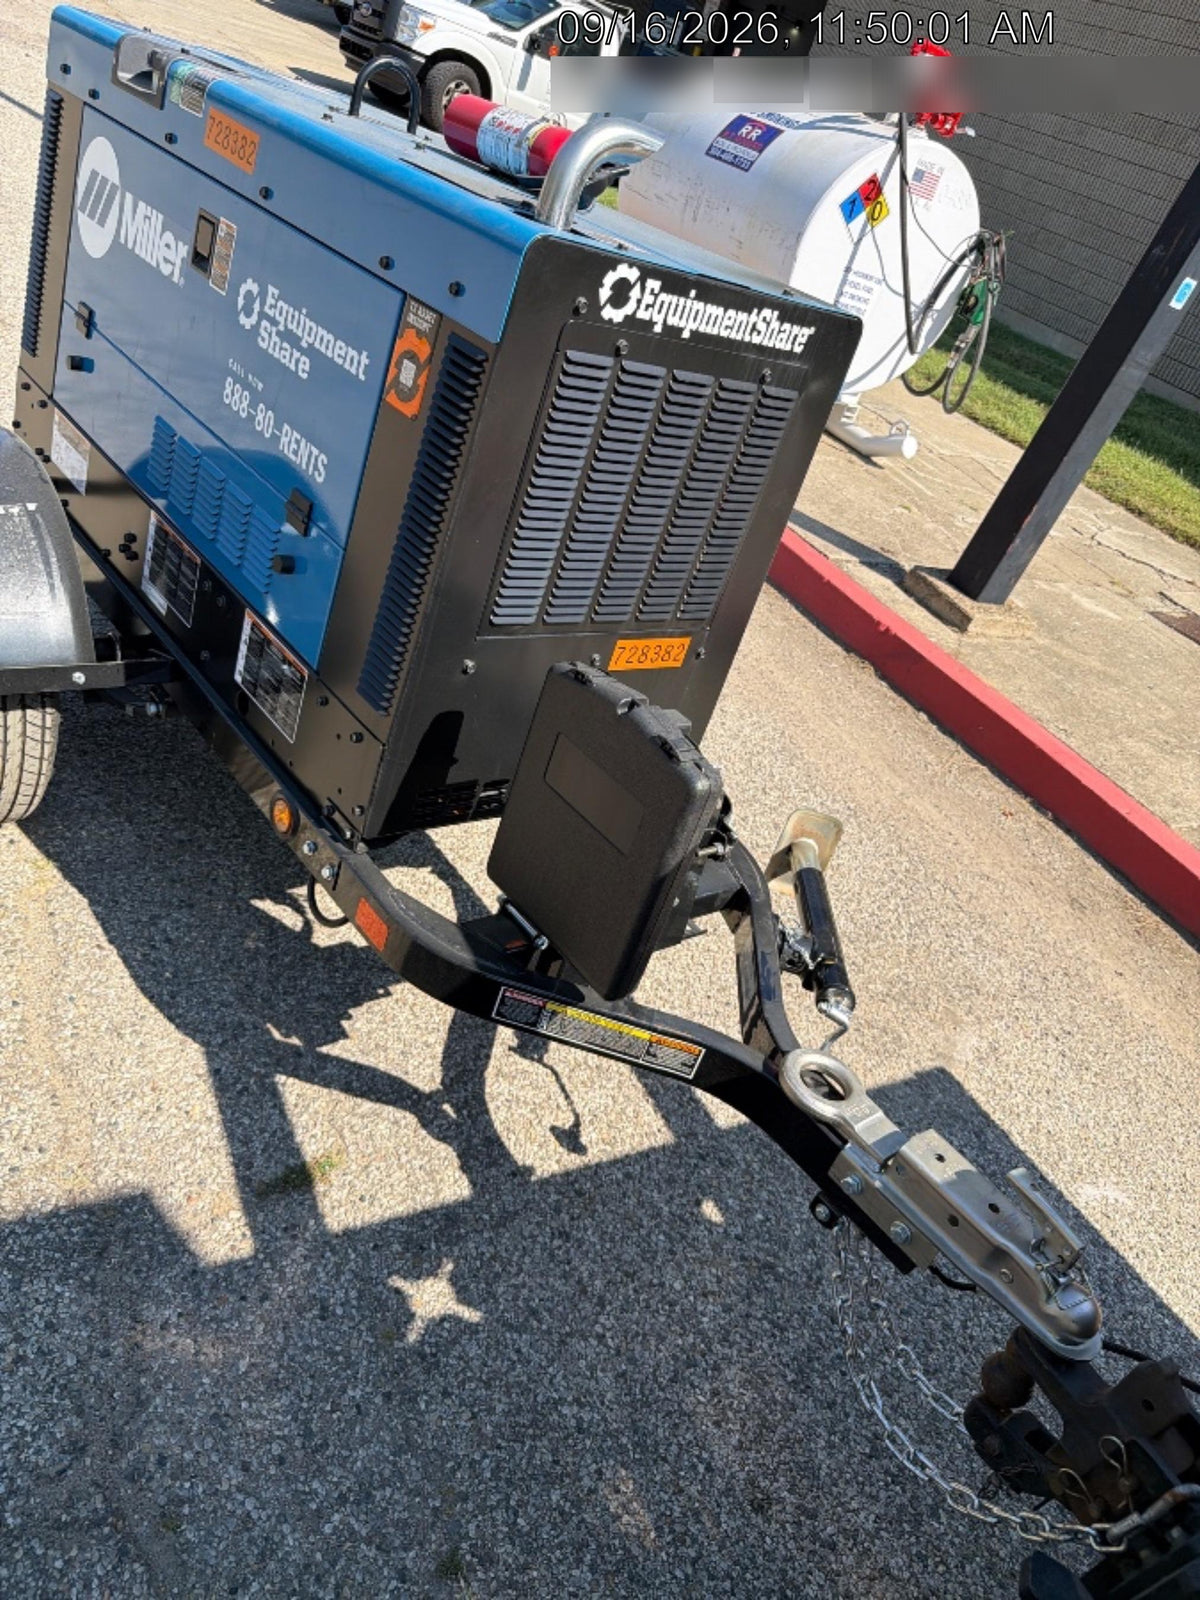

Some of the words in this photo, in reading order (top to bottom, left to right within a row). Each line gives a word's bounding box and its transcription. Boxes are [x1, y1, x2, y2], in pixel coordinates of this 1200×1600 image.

[207, 114, 257, 166] 728382
[847, 197, 858, 219] 1
[863, 179, 878, 201] 2
[871, 200, 883, 222] 0
[119, 191, 189, 284] Miller
[264, 284, 370, 381] Equipment
[636, 278, 810, 354] EquipmentShare
[258, 319, 311, 380] Share
[223, 376, 328, 484] 888-80-RENTS
[614, 643, 685, 666] 728382
